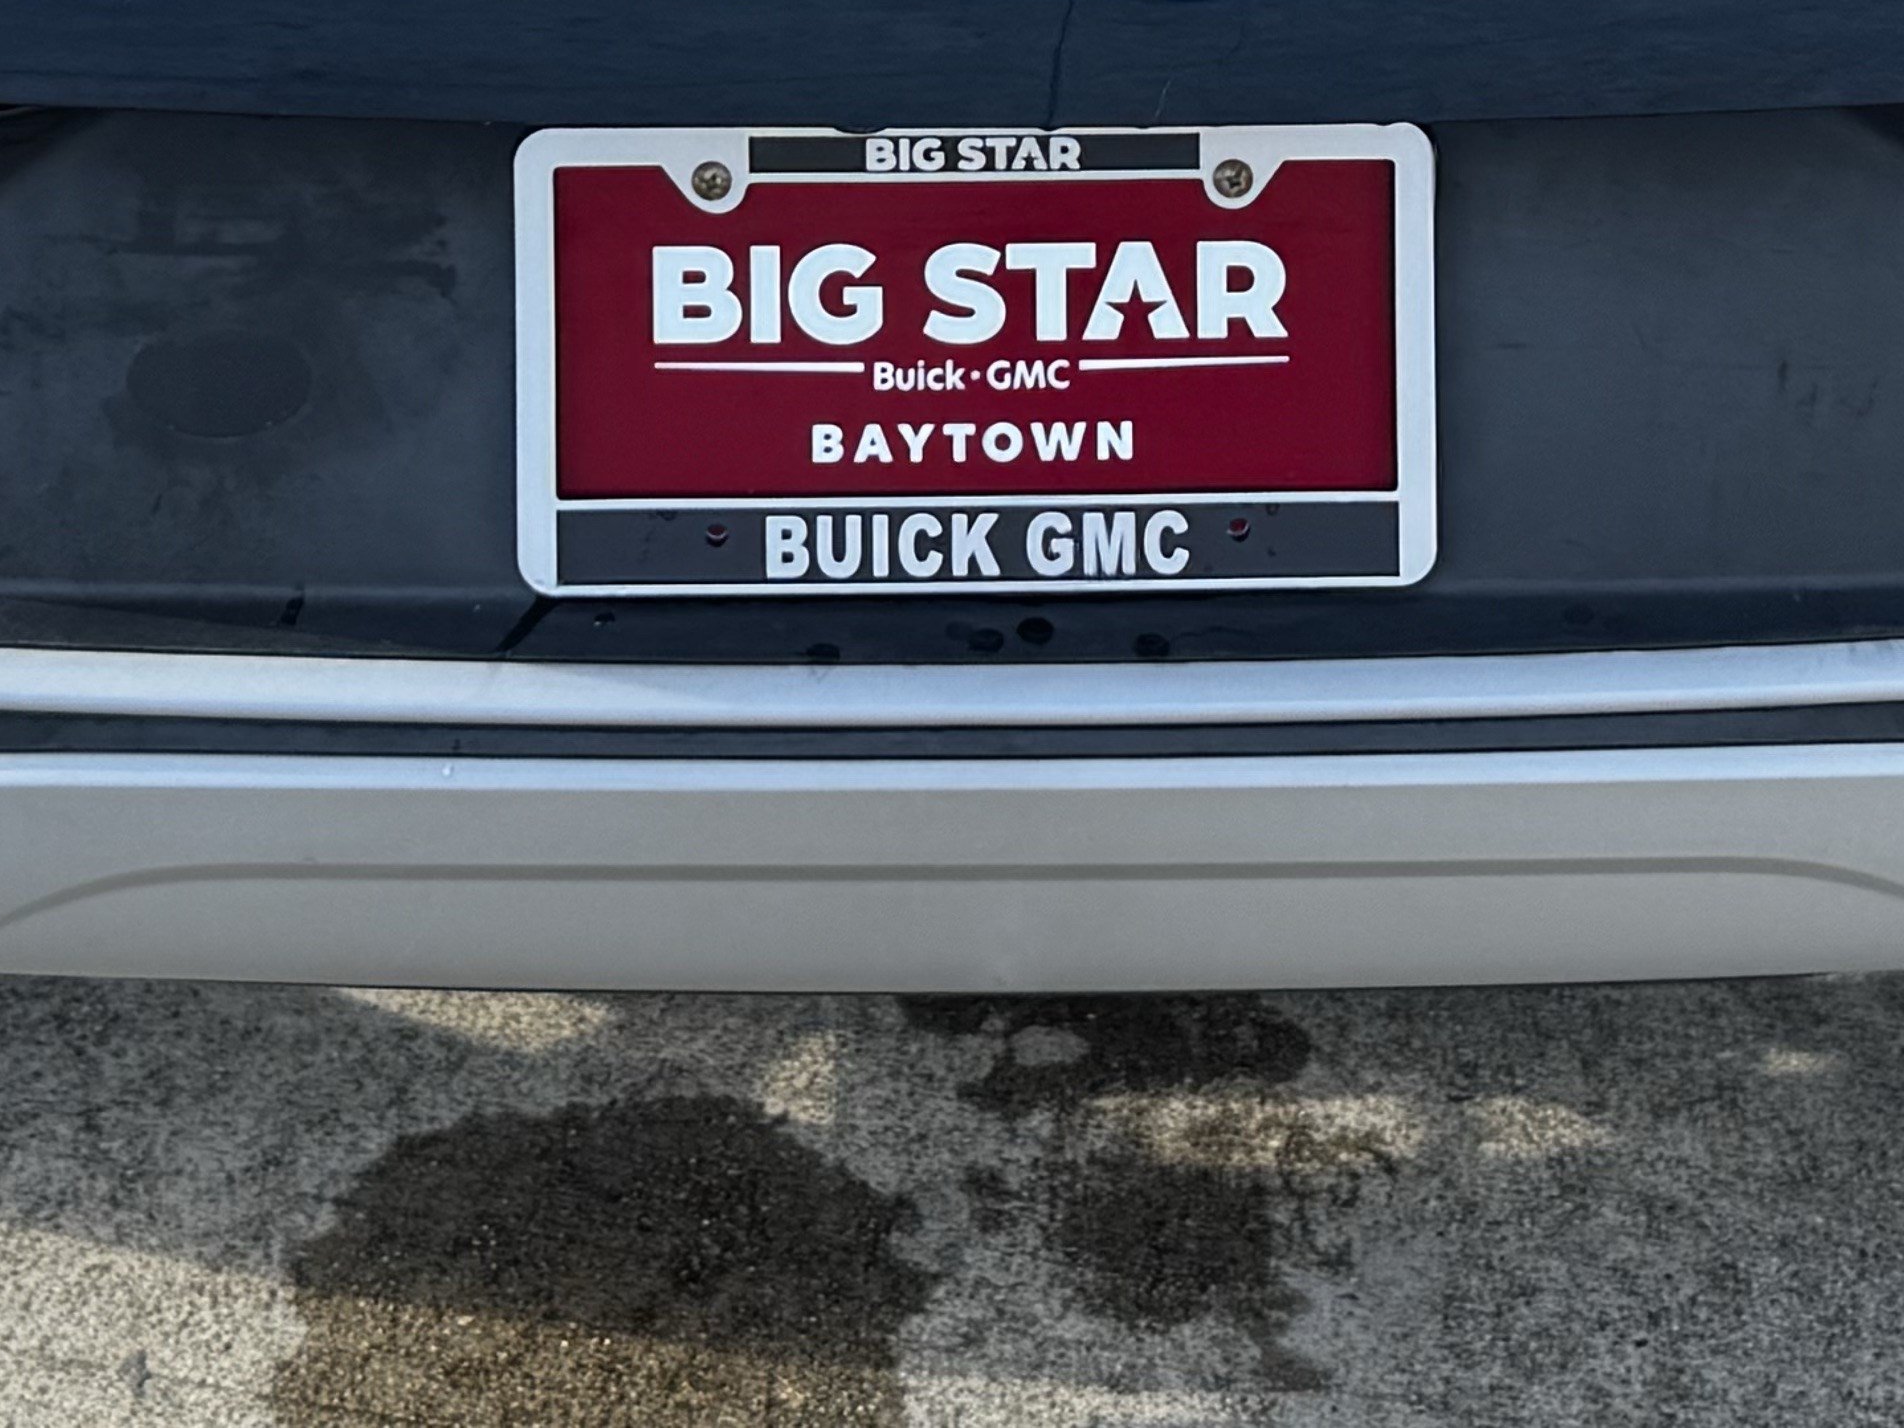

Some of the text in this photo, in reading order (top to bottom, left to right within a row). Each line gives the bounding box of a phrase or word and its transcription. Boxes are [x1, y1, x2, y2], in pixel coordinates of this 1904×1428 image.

[865, 136, 1082, 172] BIG STAR
[652, 240, 1289, 346] BIG STAR
[810, 420, 1134, 464] BAYTOWN
[764, 508, 1192, 580] BUICK GMC
